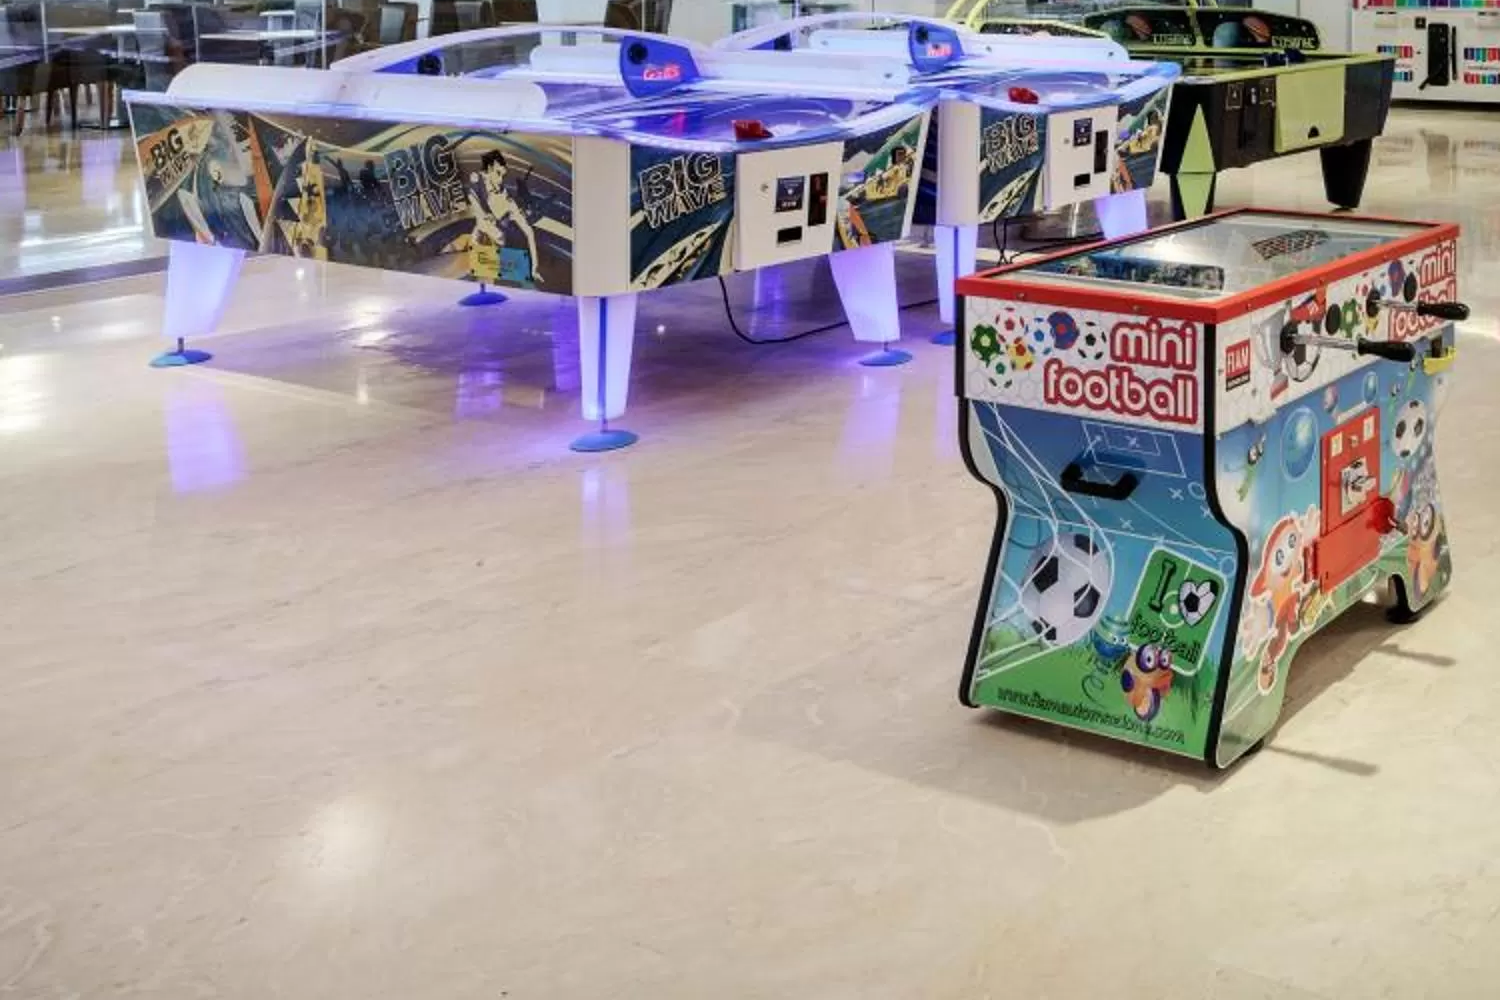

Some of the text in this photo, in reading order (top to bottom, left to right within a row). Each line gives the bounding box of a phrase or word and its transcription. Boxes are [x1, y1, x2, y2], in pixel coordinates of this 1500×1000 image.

[150, 128, 184, 169] BIG
[384, 134, 458, 201] BIG
[639, 150, 721, 207] BIG
[644, 176, 727, 229] WAVE
[394, 180, 467, 230] WAVE
[1419, 240, 1457, 288] mini
[1111, 318, 1197, 369] mini
[1045, 359, 1197, 422] football
